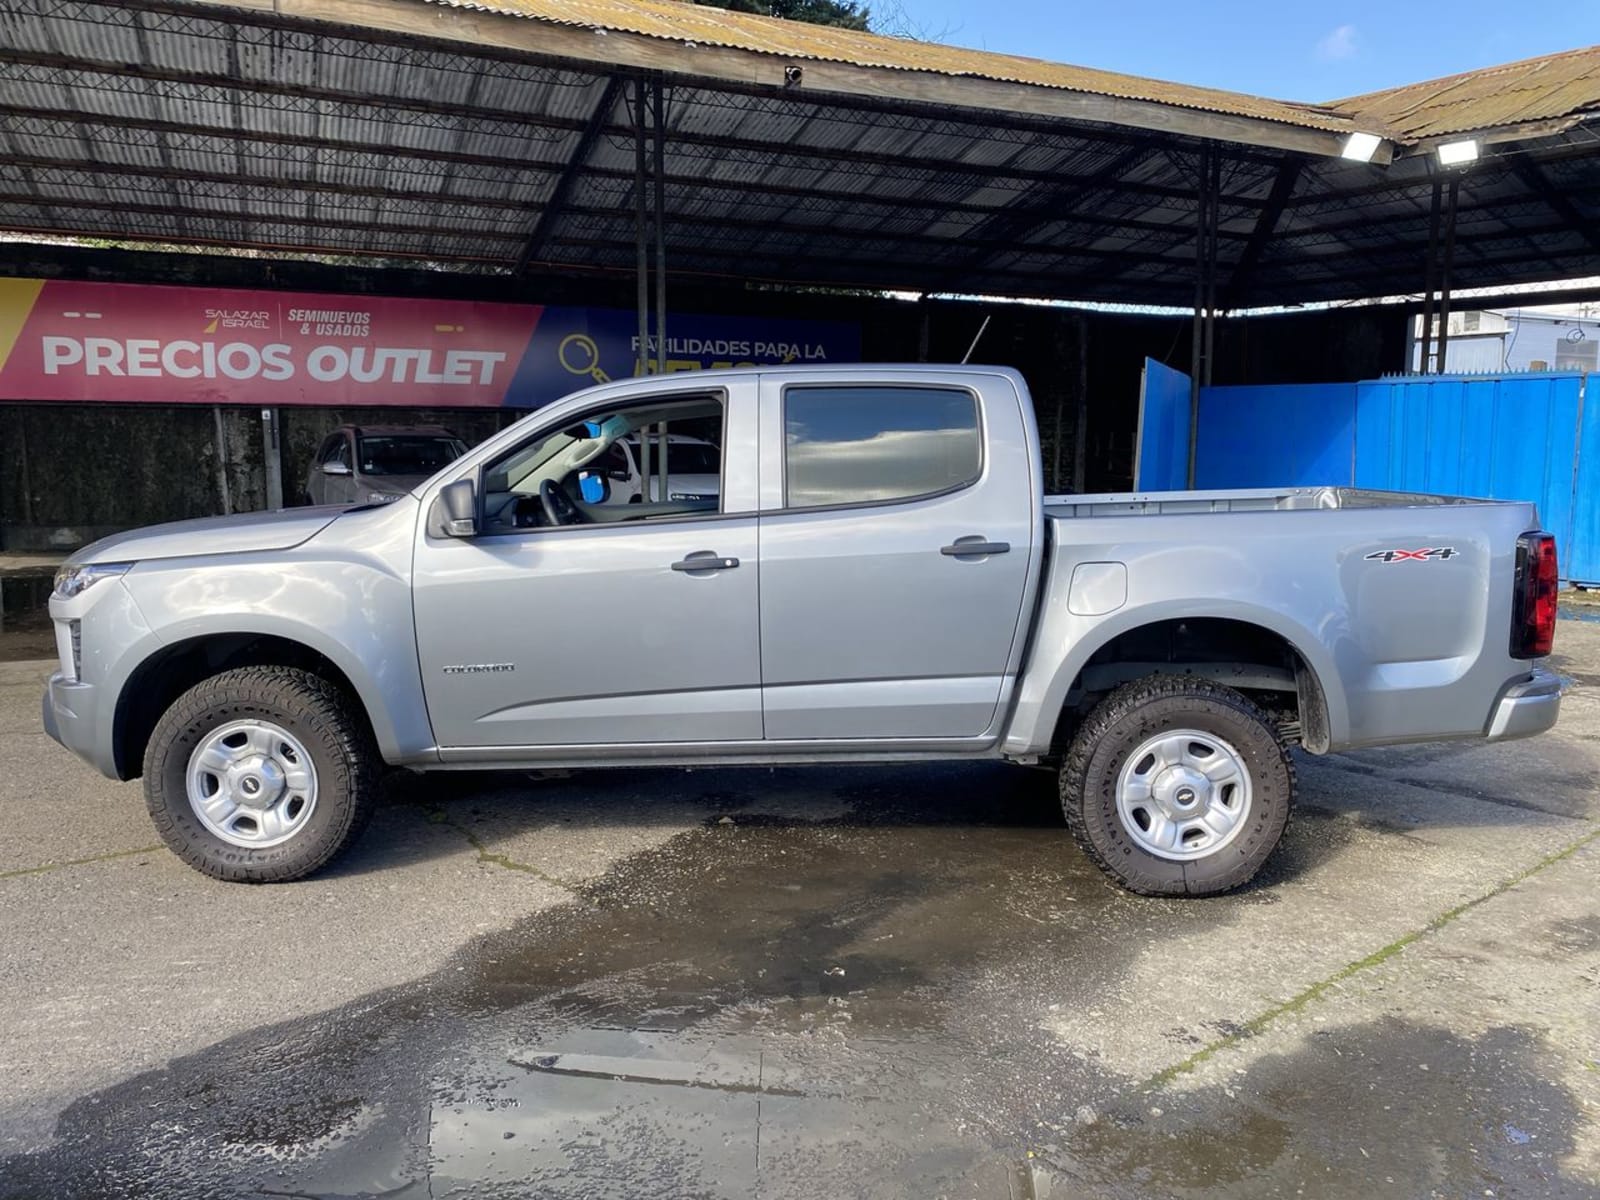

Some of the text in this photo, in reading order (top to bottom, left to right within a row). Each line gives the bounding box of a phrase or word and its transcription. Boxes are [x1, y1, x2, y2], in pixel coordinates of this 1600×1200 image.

[205, 309, 270, 320] SALAZAR
[288, 308, 371, 325] SEMINUEVOS
[222, 318, 270, 329] ISRAEL
[300, 323, 370, 336] & USADOS
[754, 341, 802, 358] PARA
[804, 344, 826, 359] LA
[42, 335, 506, 385] PRECIOS OUTLET
